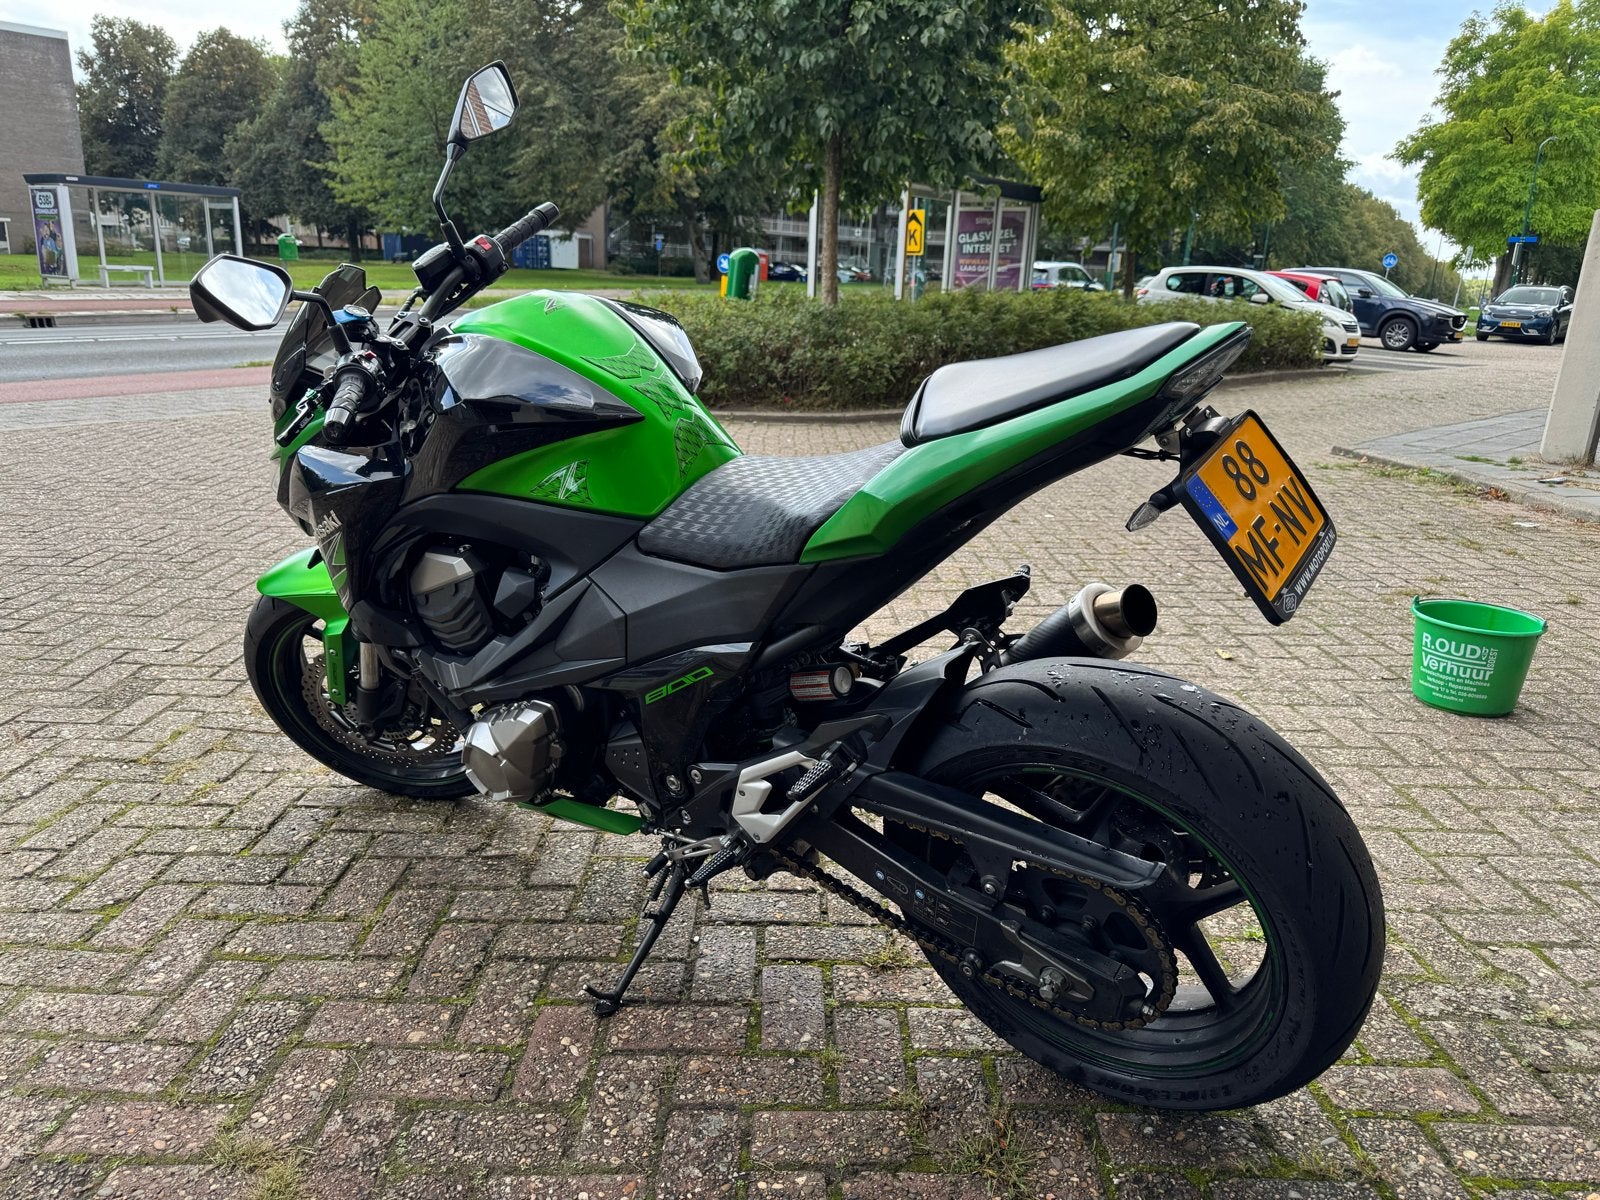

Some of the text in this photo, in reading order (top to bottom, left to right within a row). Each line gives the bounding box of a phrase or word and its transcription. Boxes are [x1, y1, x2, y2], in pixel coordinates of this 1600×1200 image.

[908, 229, 918, 246] K
[959, 229, 1016, 243] GLASVZEL
[963, 244, 1012, 254] INTERET
[1221, 439, 1269, 501] 88
[1213, 513, 1230, 531] NL
[1234, 475, 1315, 592] MF-NV
[1422, 652, 1494, 681] Verhuur
[1487, 648, 1498, 668] SOEST
[645, 666, 714, 705] 800
